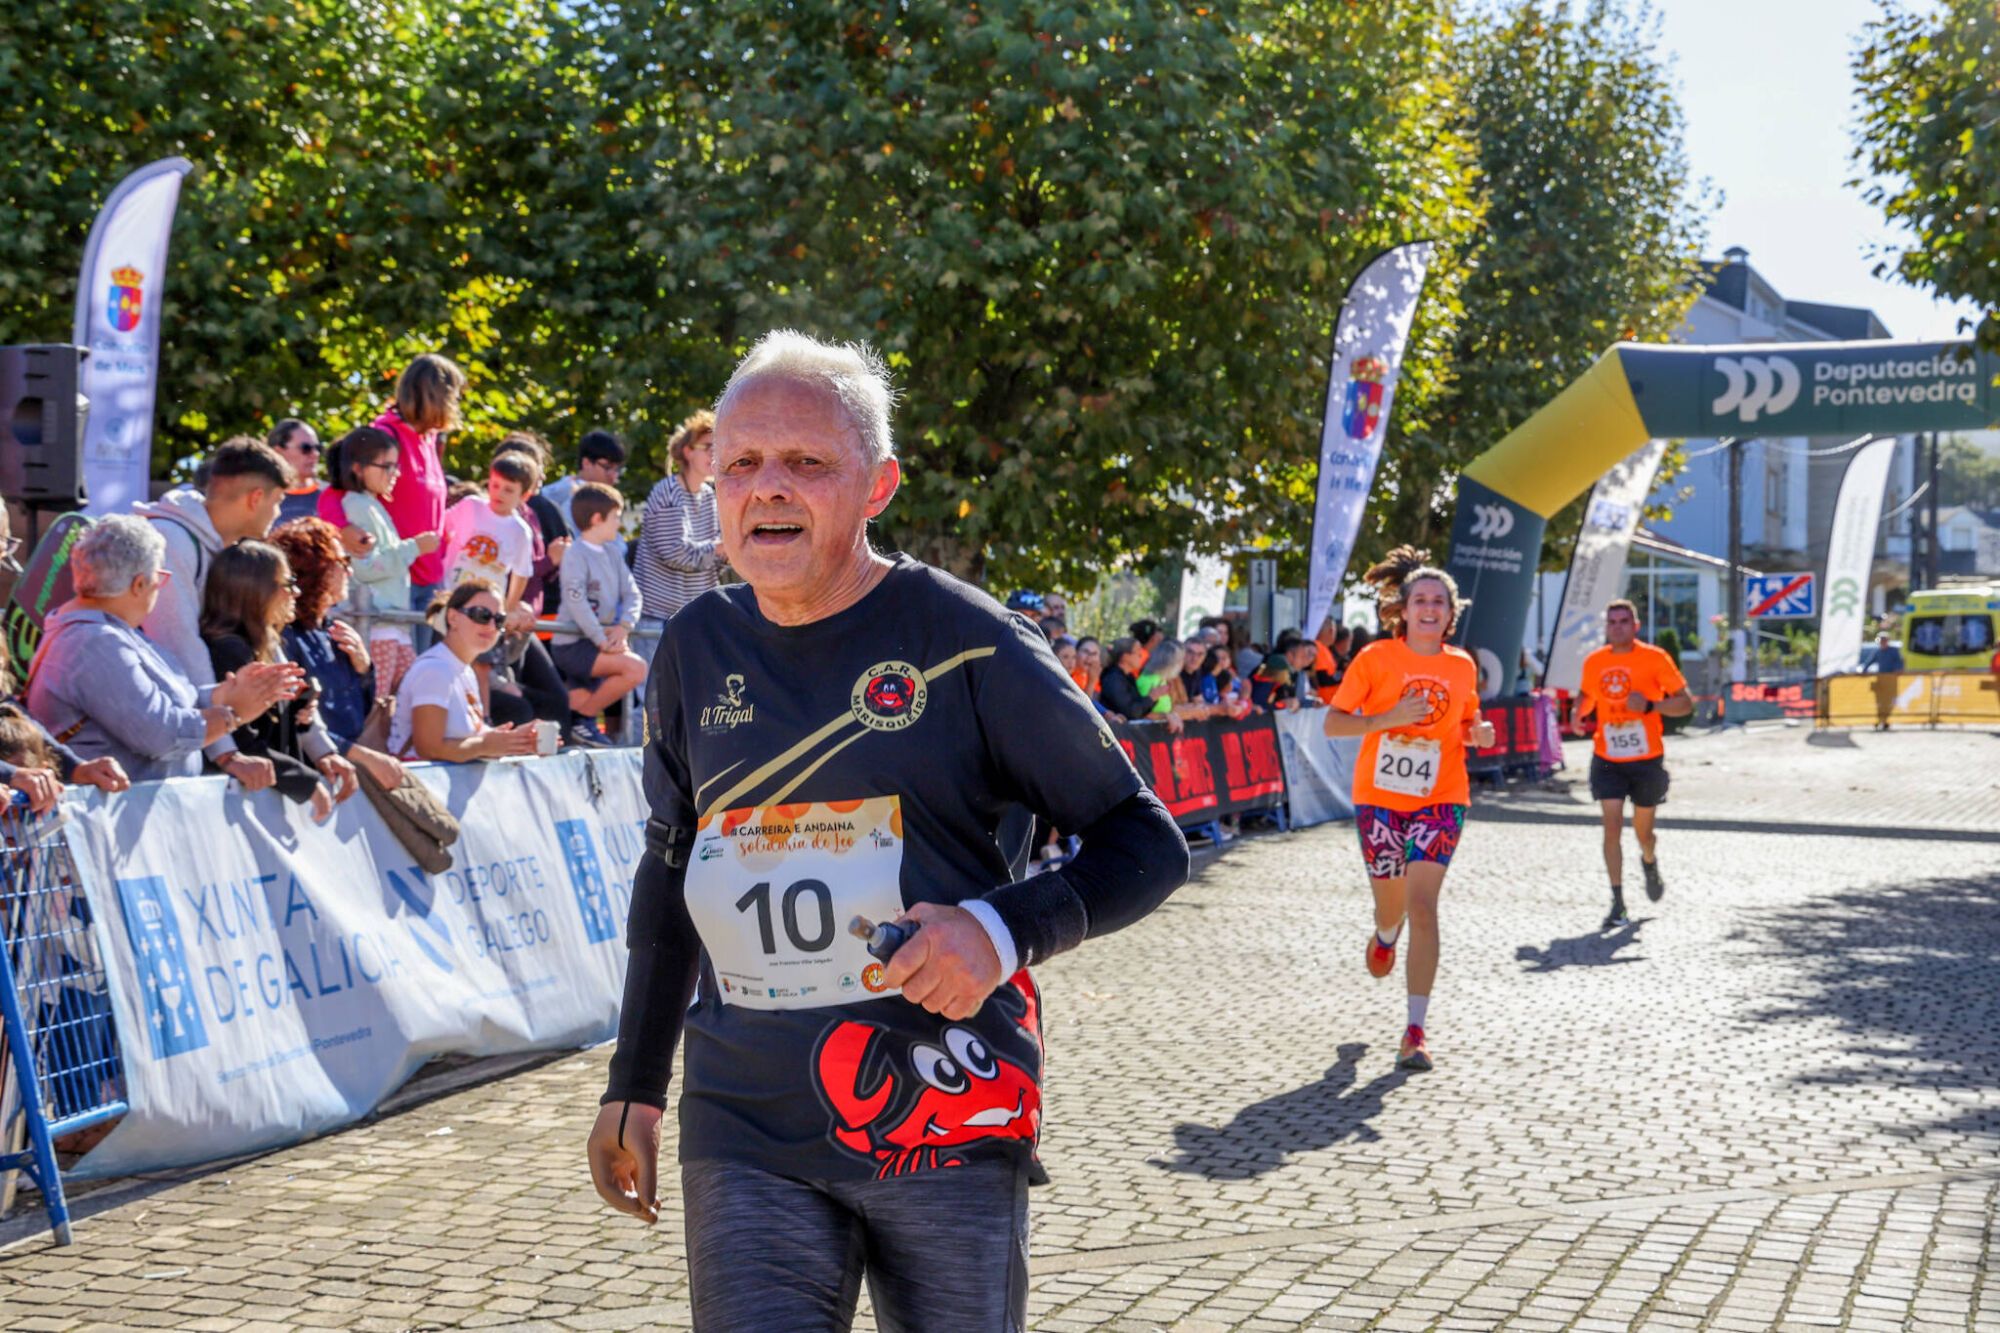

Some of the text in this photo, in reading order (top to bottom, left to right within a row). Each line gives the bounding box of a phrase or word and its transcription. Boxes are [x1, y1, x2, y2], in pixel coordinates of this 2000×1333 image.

[1814, 353, 1976, 386] Deputación
[1814, 382, 1976, 406] Pontevedra
[868, 664, 910, 679] C.A.R.
[713, 703, 754, 729] Trigal
[852, 689, 926, 729] MARISQUEIRO
[1611, 732, 1640, 749] 155
[1380, 754, 1431, 781] 204
[604, 820, 648, 866] XUNT
[739, 823, 792, 837] CARREIRA
[794, 821, 801, 833] E
[804, 820, 855, 833] ANDAINA
[447, 856, 545, 905] DEPORTE
[184, 871, 319, 946] XUNTA
[735, 878, 835, 955] 10
[467, 909, 550, 957] GALEGO
[205, 960, 255, 1024] DE
[313, 1027, 372, 1050] Pontevedra
